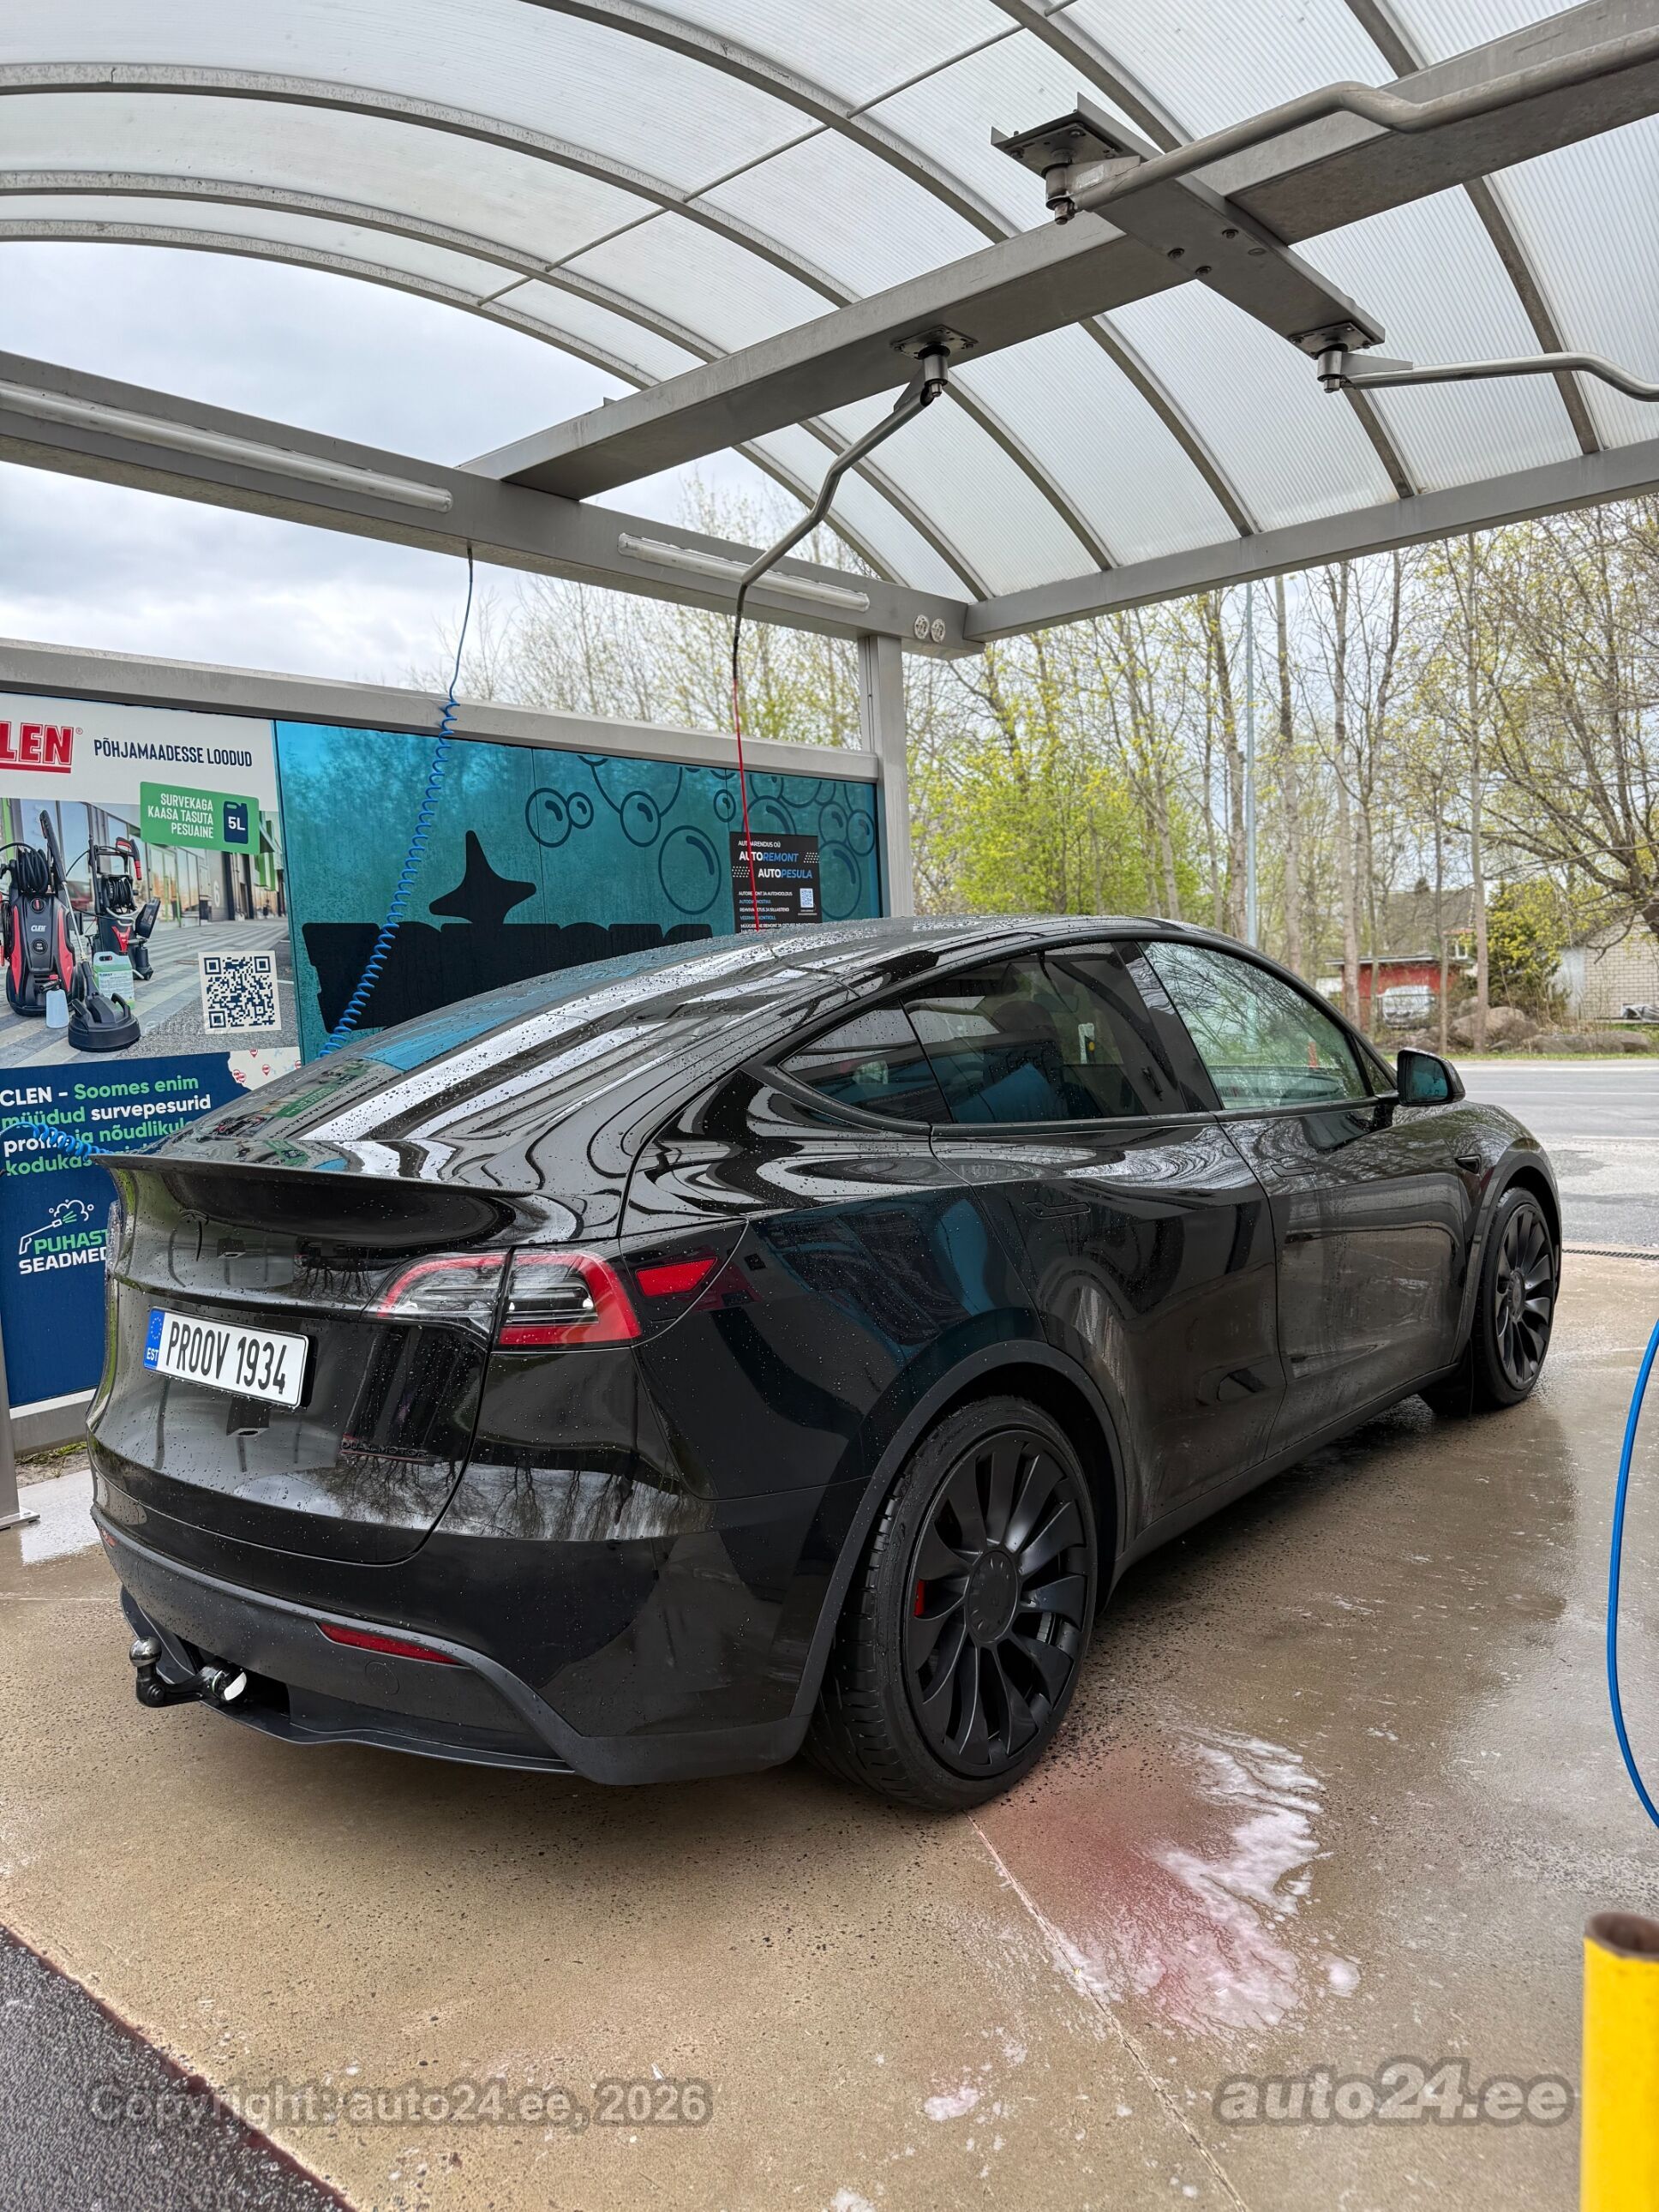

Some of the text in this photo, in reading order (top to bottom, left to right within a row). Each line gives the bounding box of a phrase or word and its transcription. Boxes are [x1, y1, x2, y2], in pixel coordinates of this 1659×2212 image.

[0, 721, 74, 765] LEN
[93, 737, 253, 767] PÕHJAMAADESSE LOODUD
[160, 793, 213, 812] SURVEKAGA
[147, 805, 213, 825] KAASA TASUTA
[227, 816, 246, 831] 5L
[171, 822, 214, 839] PESUAINE
[758, 868, 813, 878] AUTOPESULA
[0, 1086, 52, 1106] CLEN
[74, 1082, 150, 1100] Soomes
[154, 1075, 199, 1092] enim
[2, 1094, 212, 1130] müüdud survepesurid
[99, 1117, 194, 1142] nõudlikul
[146, 1347, 159, 1361] EST
[166, 1321, 287, 1394] PROOV 1934
